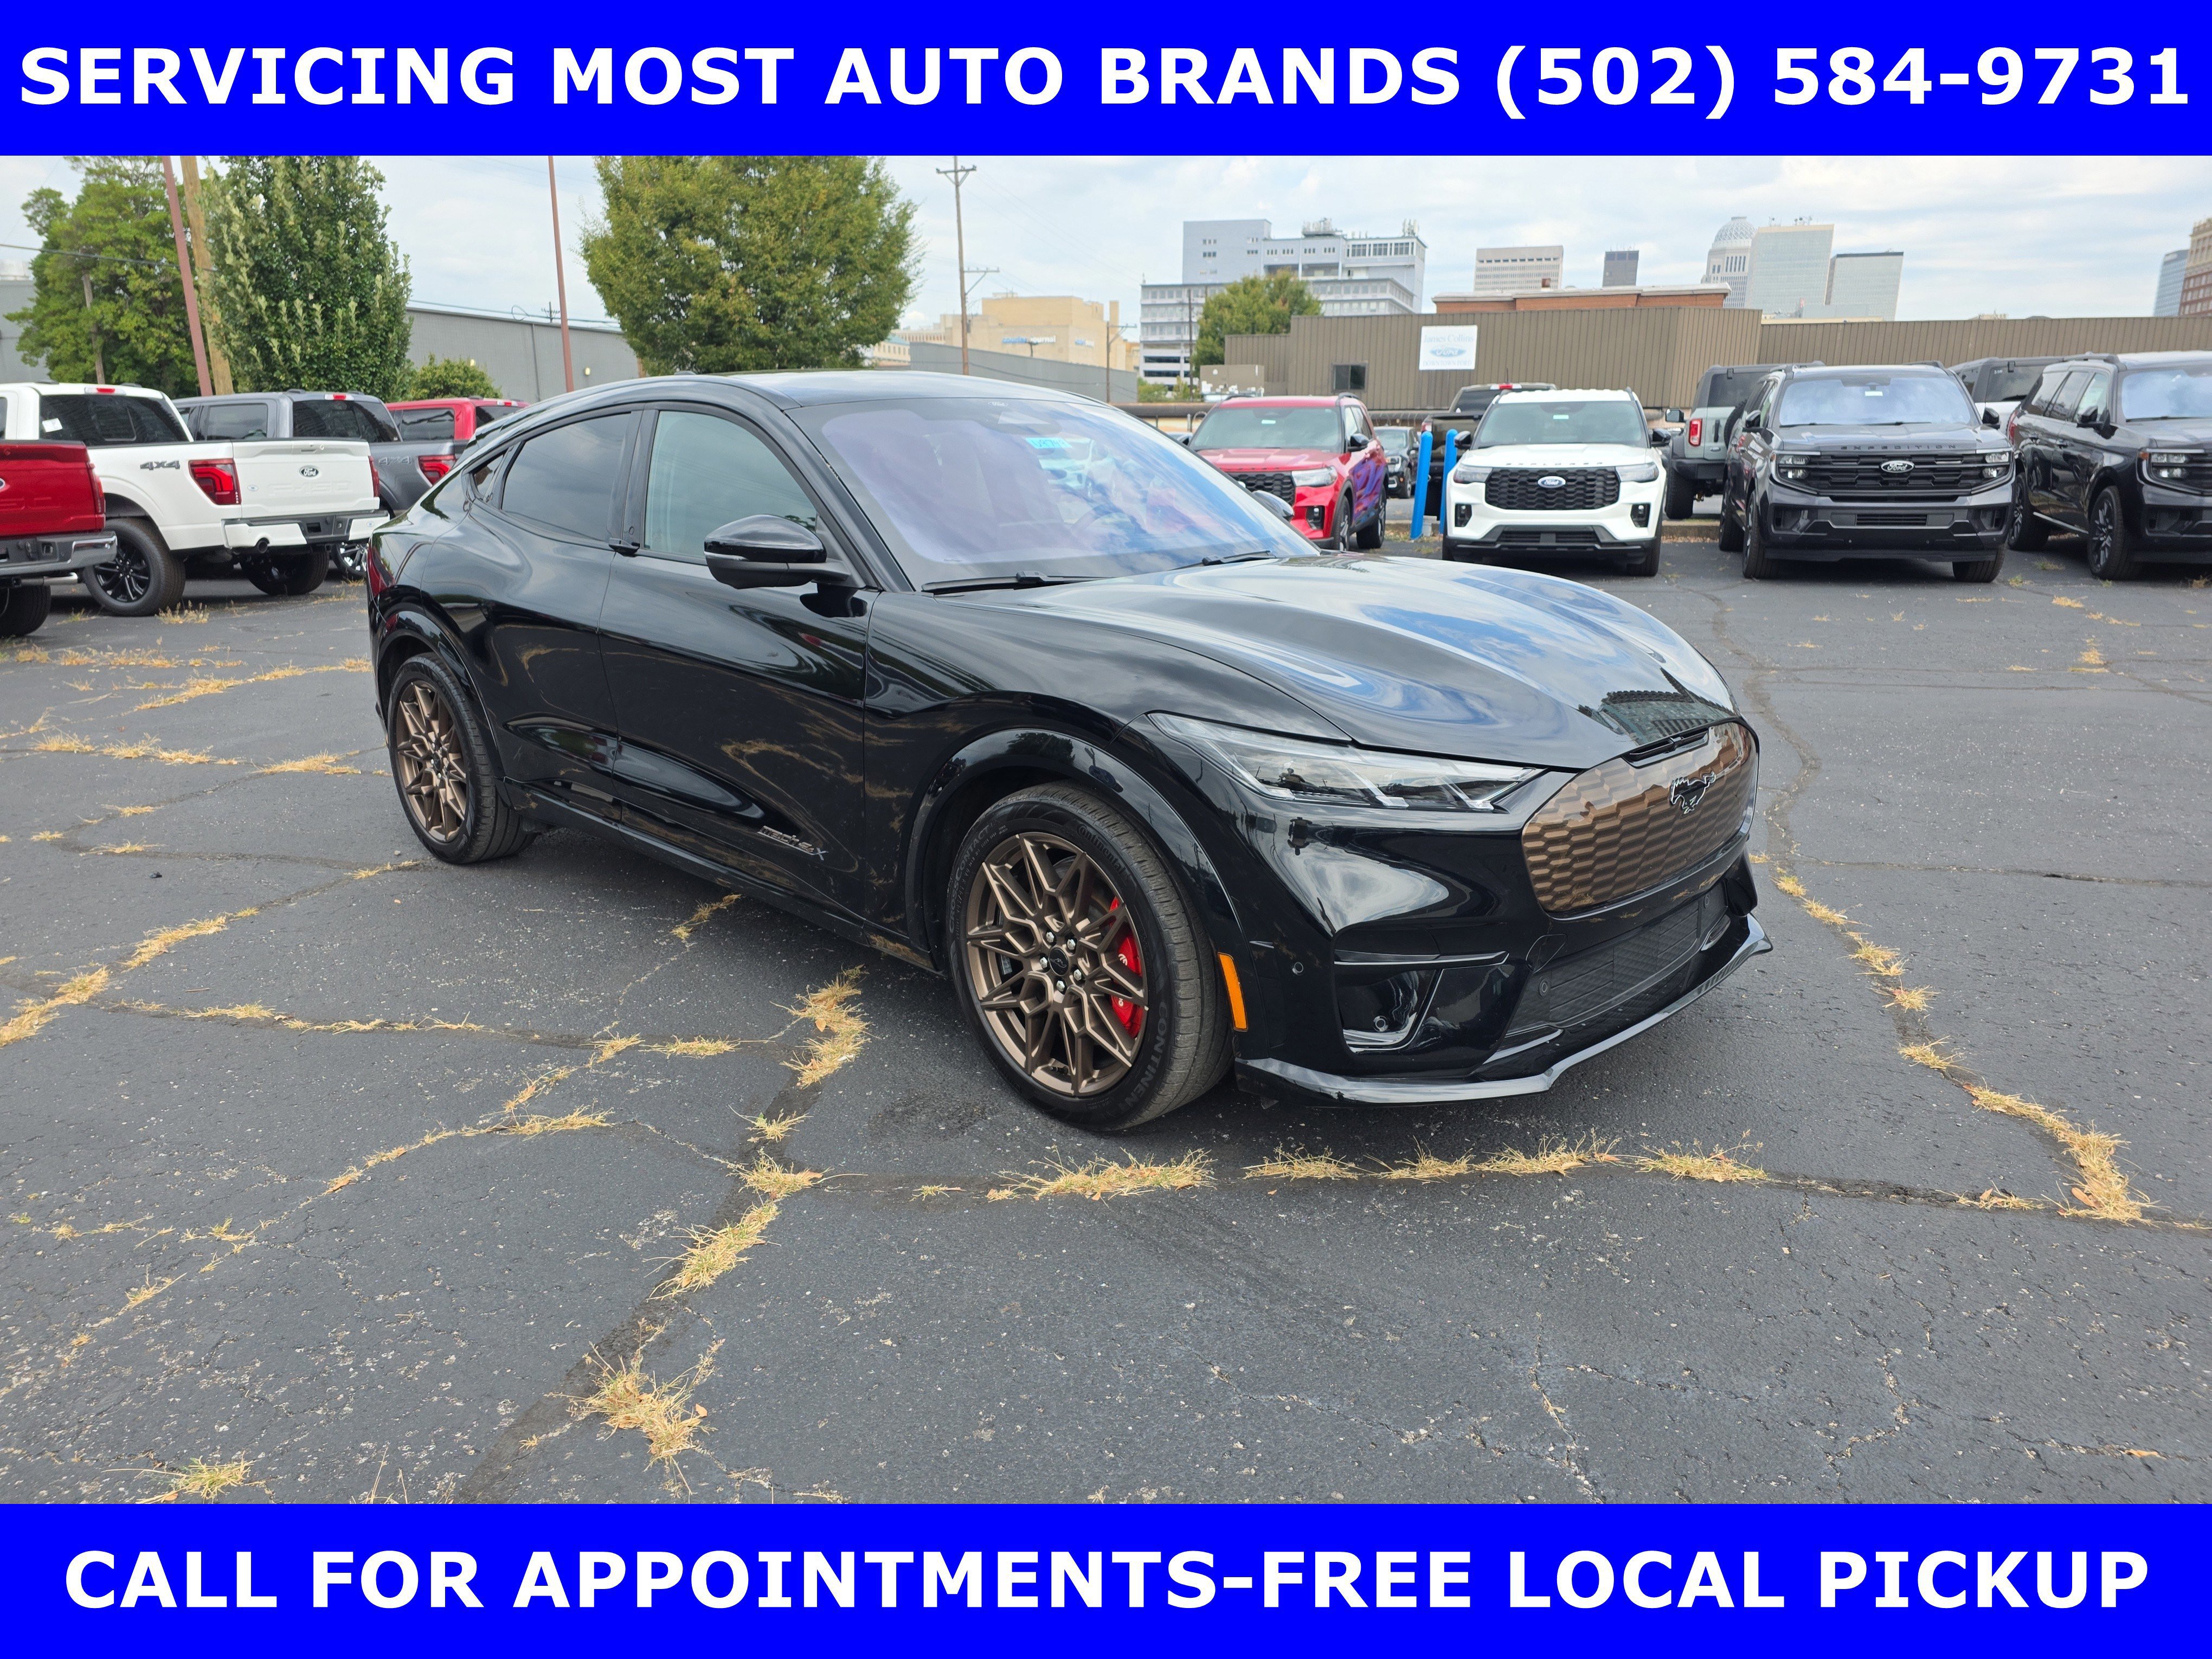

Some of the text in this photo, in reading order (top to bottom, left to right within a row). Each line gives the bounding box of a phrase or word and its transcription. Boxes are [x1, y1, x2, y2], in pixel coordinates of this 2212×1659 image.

[1424, 334, 1474, 343] James Collins
[1076, 823, 1127, 875] Continental
